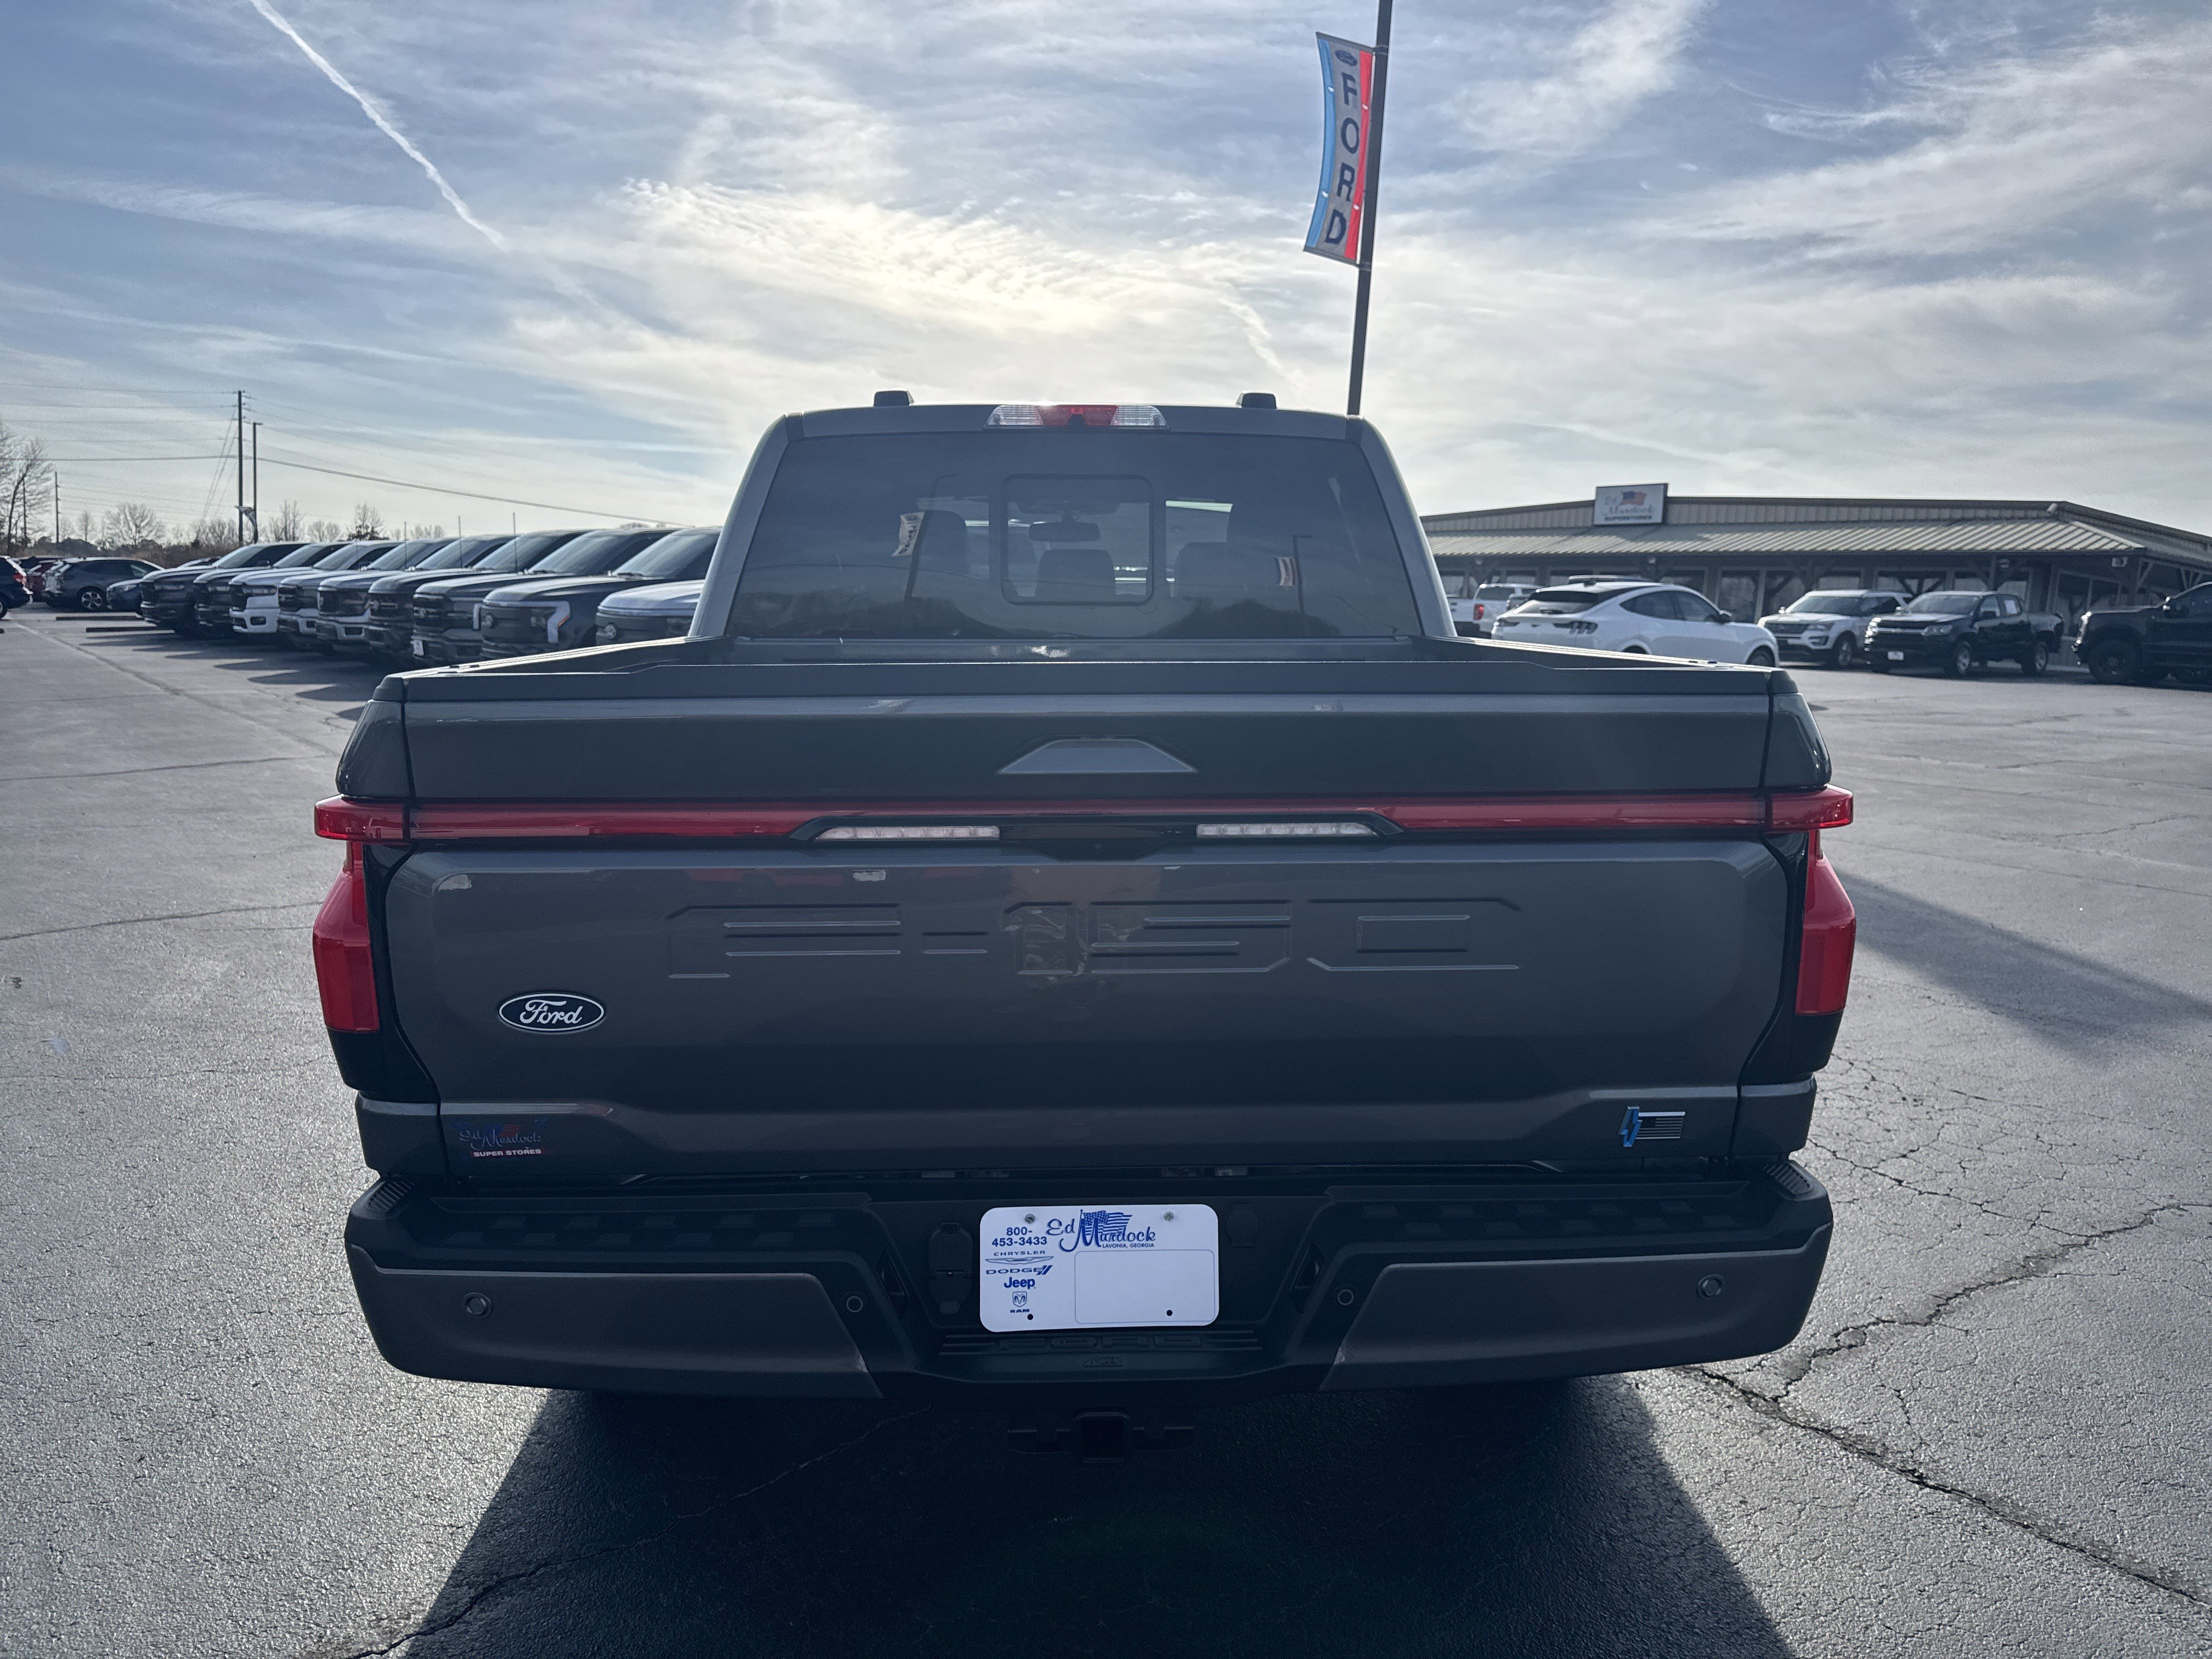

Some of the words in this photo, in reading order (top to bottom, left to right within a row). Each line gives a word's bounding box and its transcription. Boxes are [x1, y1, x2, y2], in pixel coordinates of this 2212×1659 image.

[1324, 71, 1359, 245] FORD
[520, 999, 583, 1024] Ford
[459, 1129, 481, 1142] Ed
[471, 1128, 543, 1150] Murdock
[1006, 1227, 1032, 1235] 800-
[1046, 1218, 1075, 1235] Ed
[1059, 1209, 1156, 1252] Murdock
[991, 1236, 1047, 1246] 453-3433
[1003, 1277, 1036, 1289] Jeep
